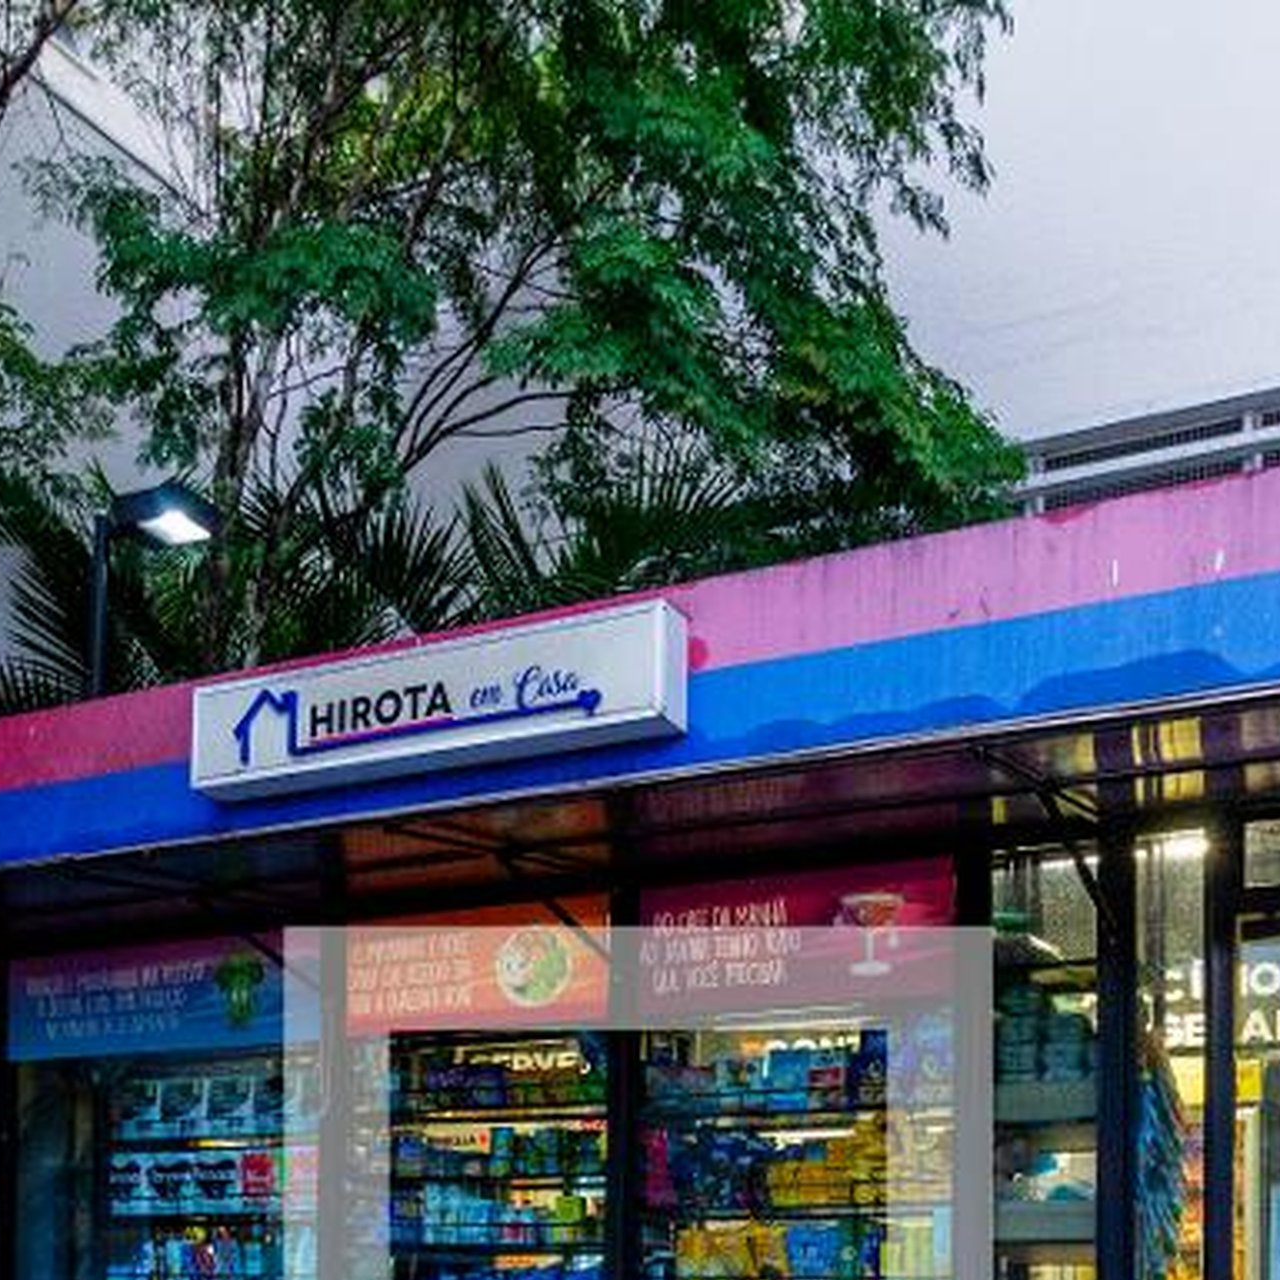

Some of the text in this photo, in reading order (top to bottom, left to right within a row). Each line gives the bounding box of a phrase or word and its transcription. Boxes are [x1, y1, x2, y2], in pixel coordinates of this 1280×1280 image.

[309, 665, 579, 737] HIROTA em Casa
